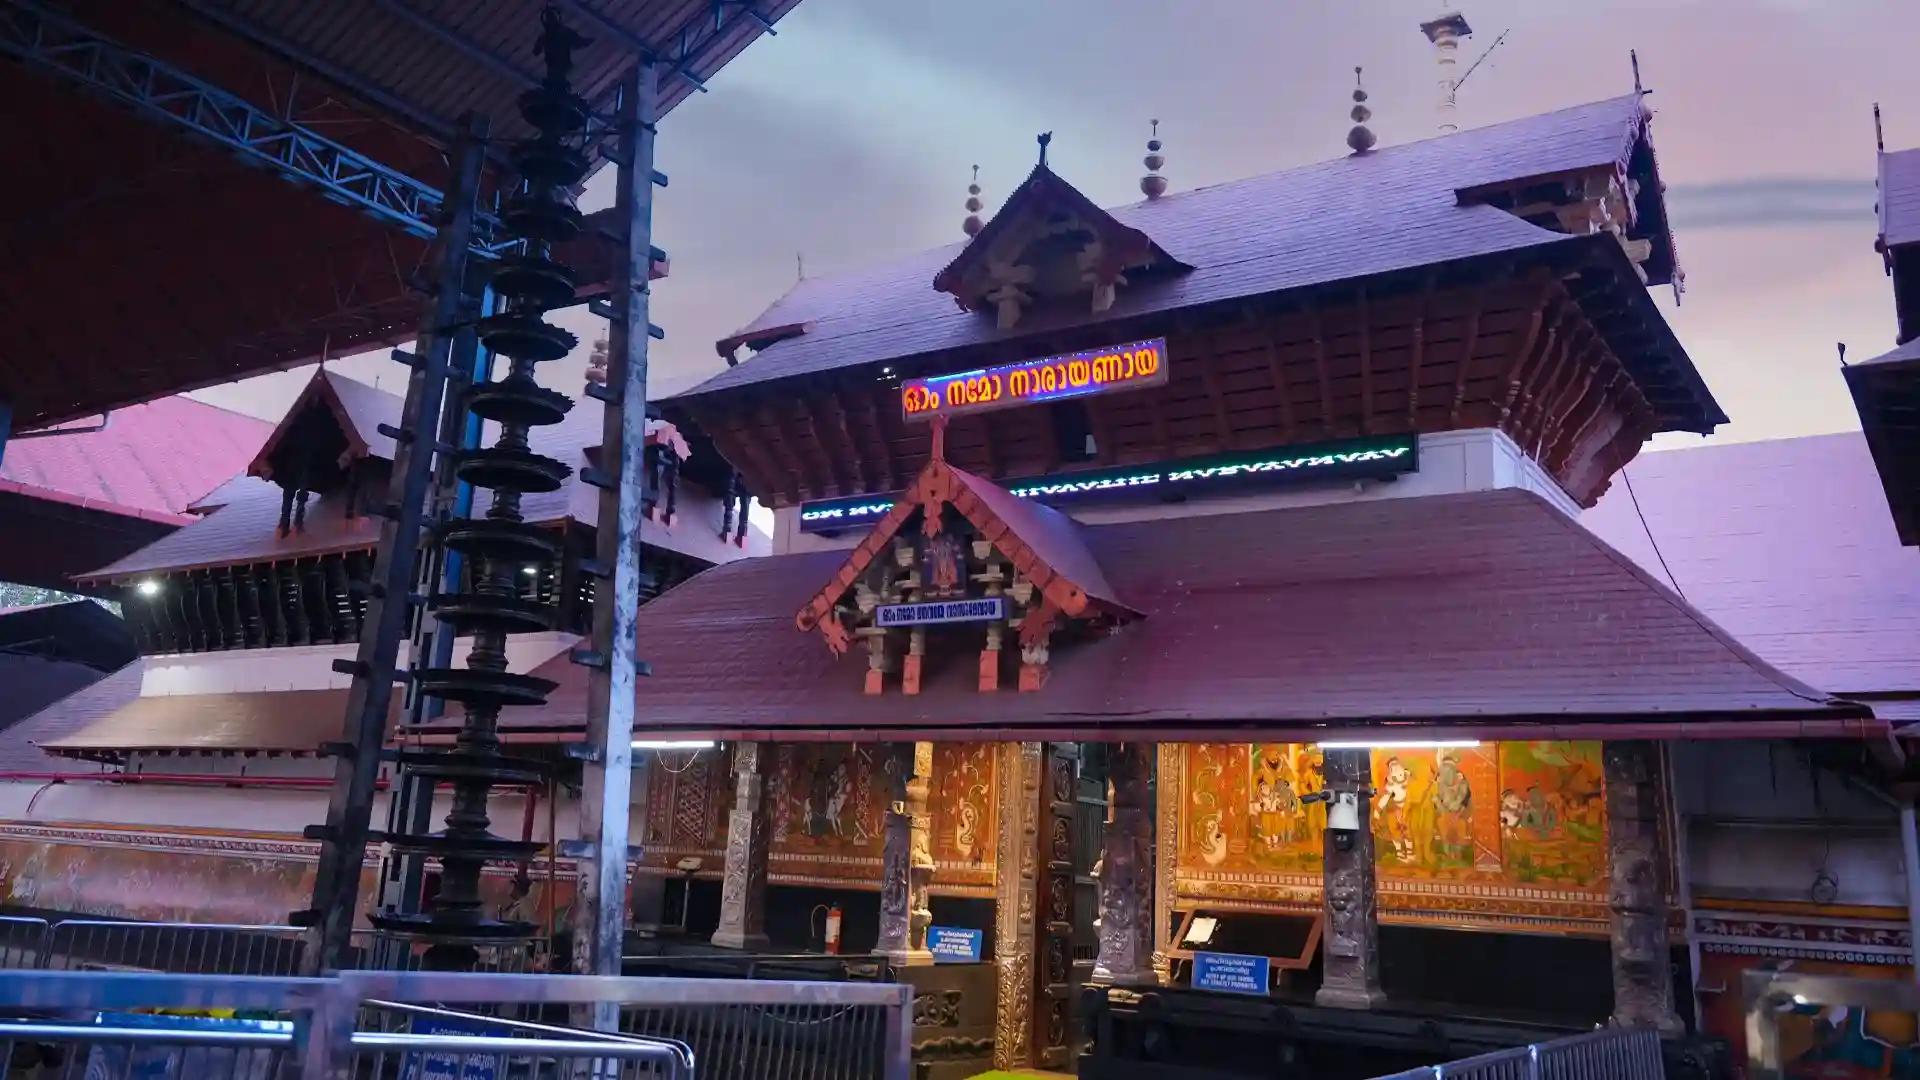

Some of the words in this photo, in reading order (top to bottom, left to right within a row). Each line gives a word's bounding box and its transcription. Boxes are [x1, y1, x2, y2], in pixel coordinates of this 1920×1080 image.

[903, 386, 940, 412] ഓം
[946, 375, 1002, 405] നമോ
[1009, 348, 1160, 398] നാരായണായ
